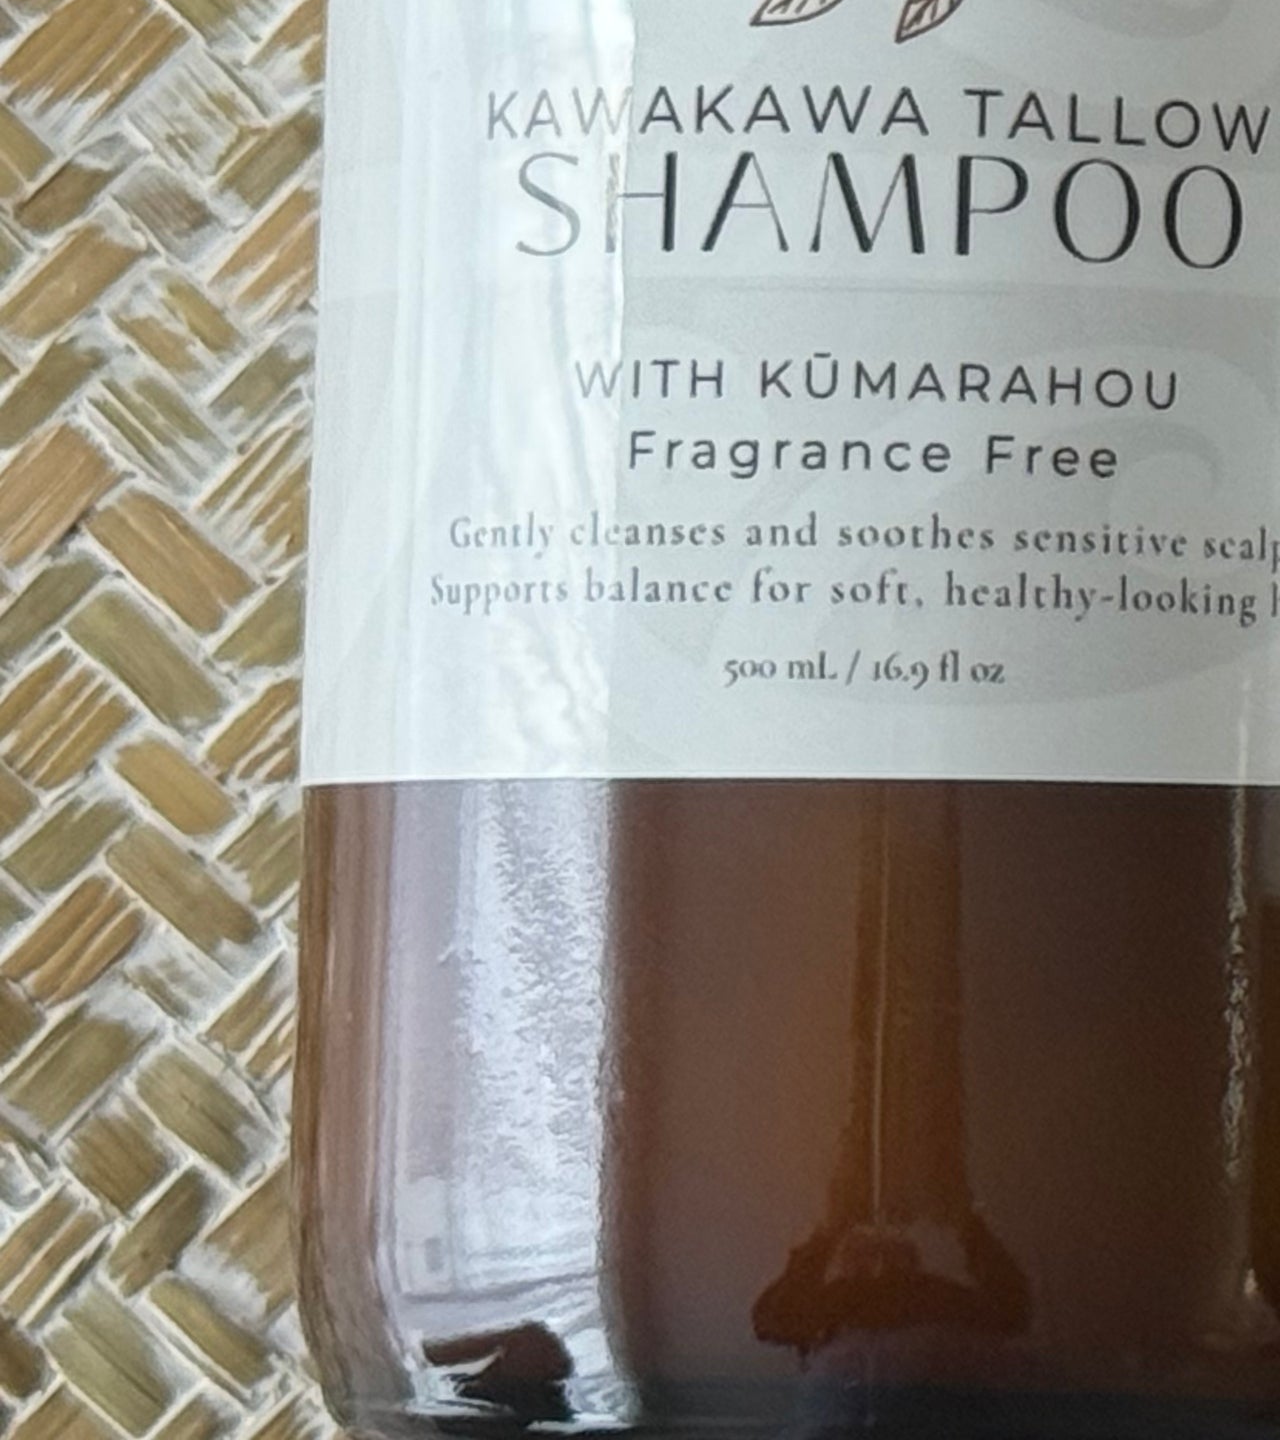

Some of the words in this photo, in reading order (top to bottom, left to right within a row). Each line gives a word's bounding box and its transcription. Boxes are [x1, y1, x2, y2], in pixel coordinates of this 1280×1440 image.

[487, 83, 930, 140] KAWAKAWA
[963, 89, 1271, 154] TALLOW
[517, 147, 1243, 270] SHAMPOO
[575, 358, 724, 399] WITH
[759, 351, 1177, 411] KŪMARAHOU
[628, 429, 952, 480] Fragrance
[985, 434, 1118, 480] Free
[448, 510, 555, 561] Gently
[569, 508, 726, 548] cleanses
[745, 510, 818, 548] and
[837, 511, 995, 551] soothes
[1013, 522, 1188, 558] sensitive
[430, 571, 569, 613] Supports
[583, 565, 733, 604] balance
[751, 565, 812, 604] for
[830, 567, 924, 610] soft,
[944, 569, 1258, 626] healthy-looking
[723, 658, 778, 689] 500
[787, 649, 839, 681] mL
[844, 648, 862, 687] /
[871, 651, 930, 691] 16.9
[938, 648, 960, 683] fl
[969, 662, 1006, 685] oz
